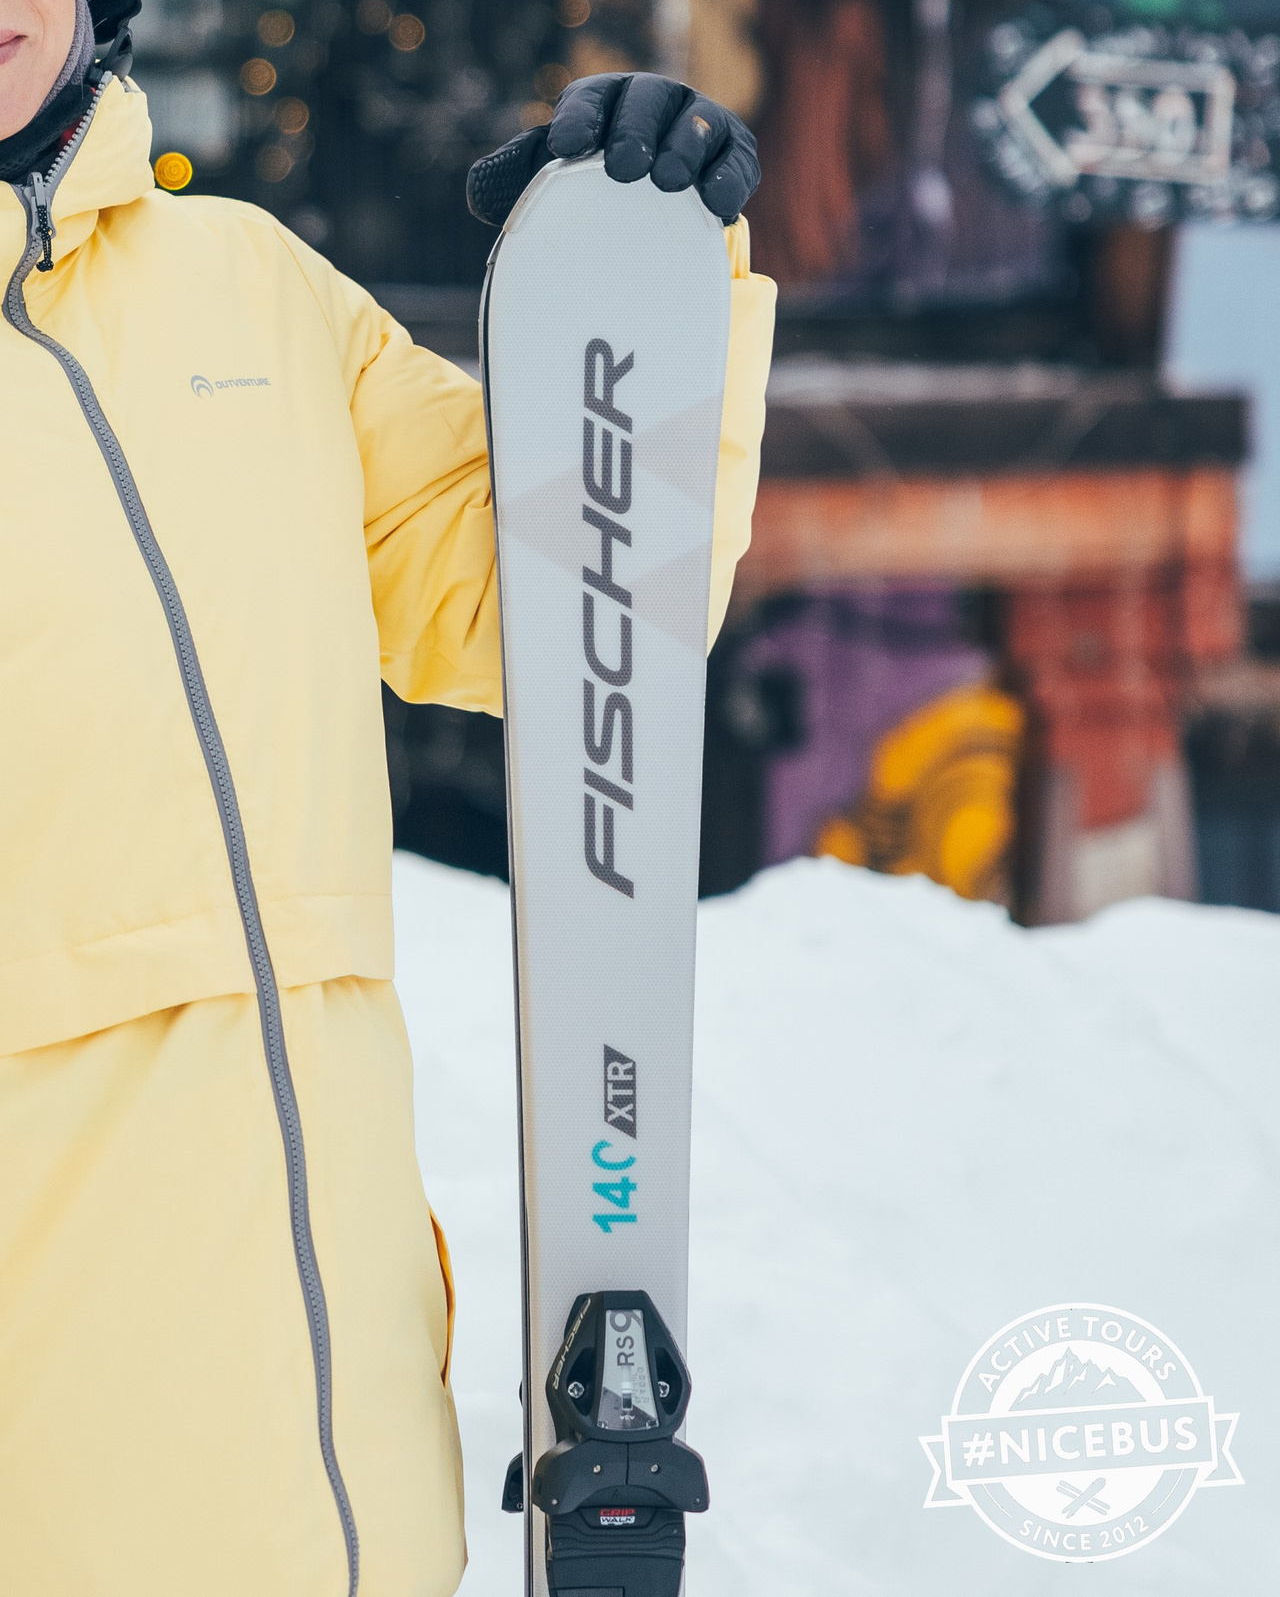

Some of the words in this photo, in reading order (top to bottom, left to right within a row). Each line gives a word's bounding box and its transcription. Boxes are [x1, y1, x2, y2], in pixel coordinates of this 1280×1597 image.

[214, 378, 271, 389] OUTVENTURE
[582, 337, 635, 899] FISCHER
[607, 1061, 634, 1123] XTR
[552, 1297, 591, 1390] FISCHER
[600, 1508, 635, 1516] GRIP
